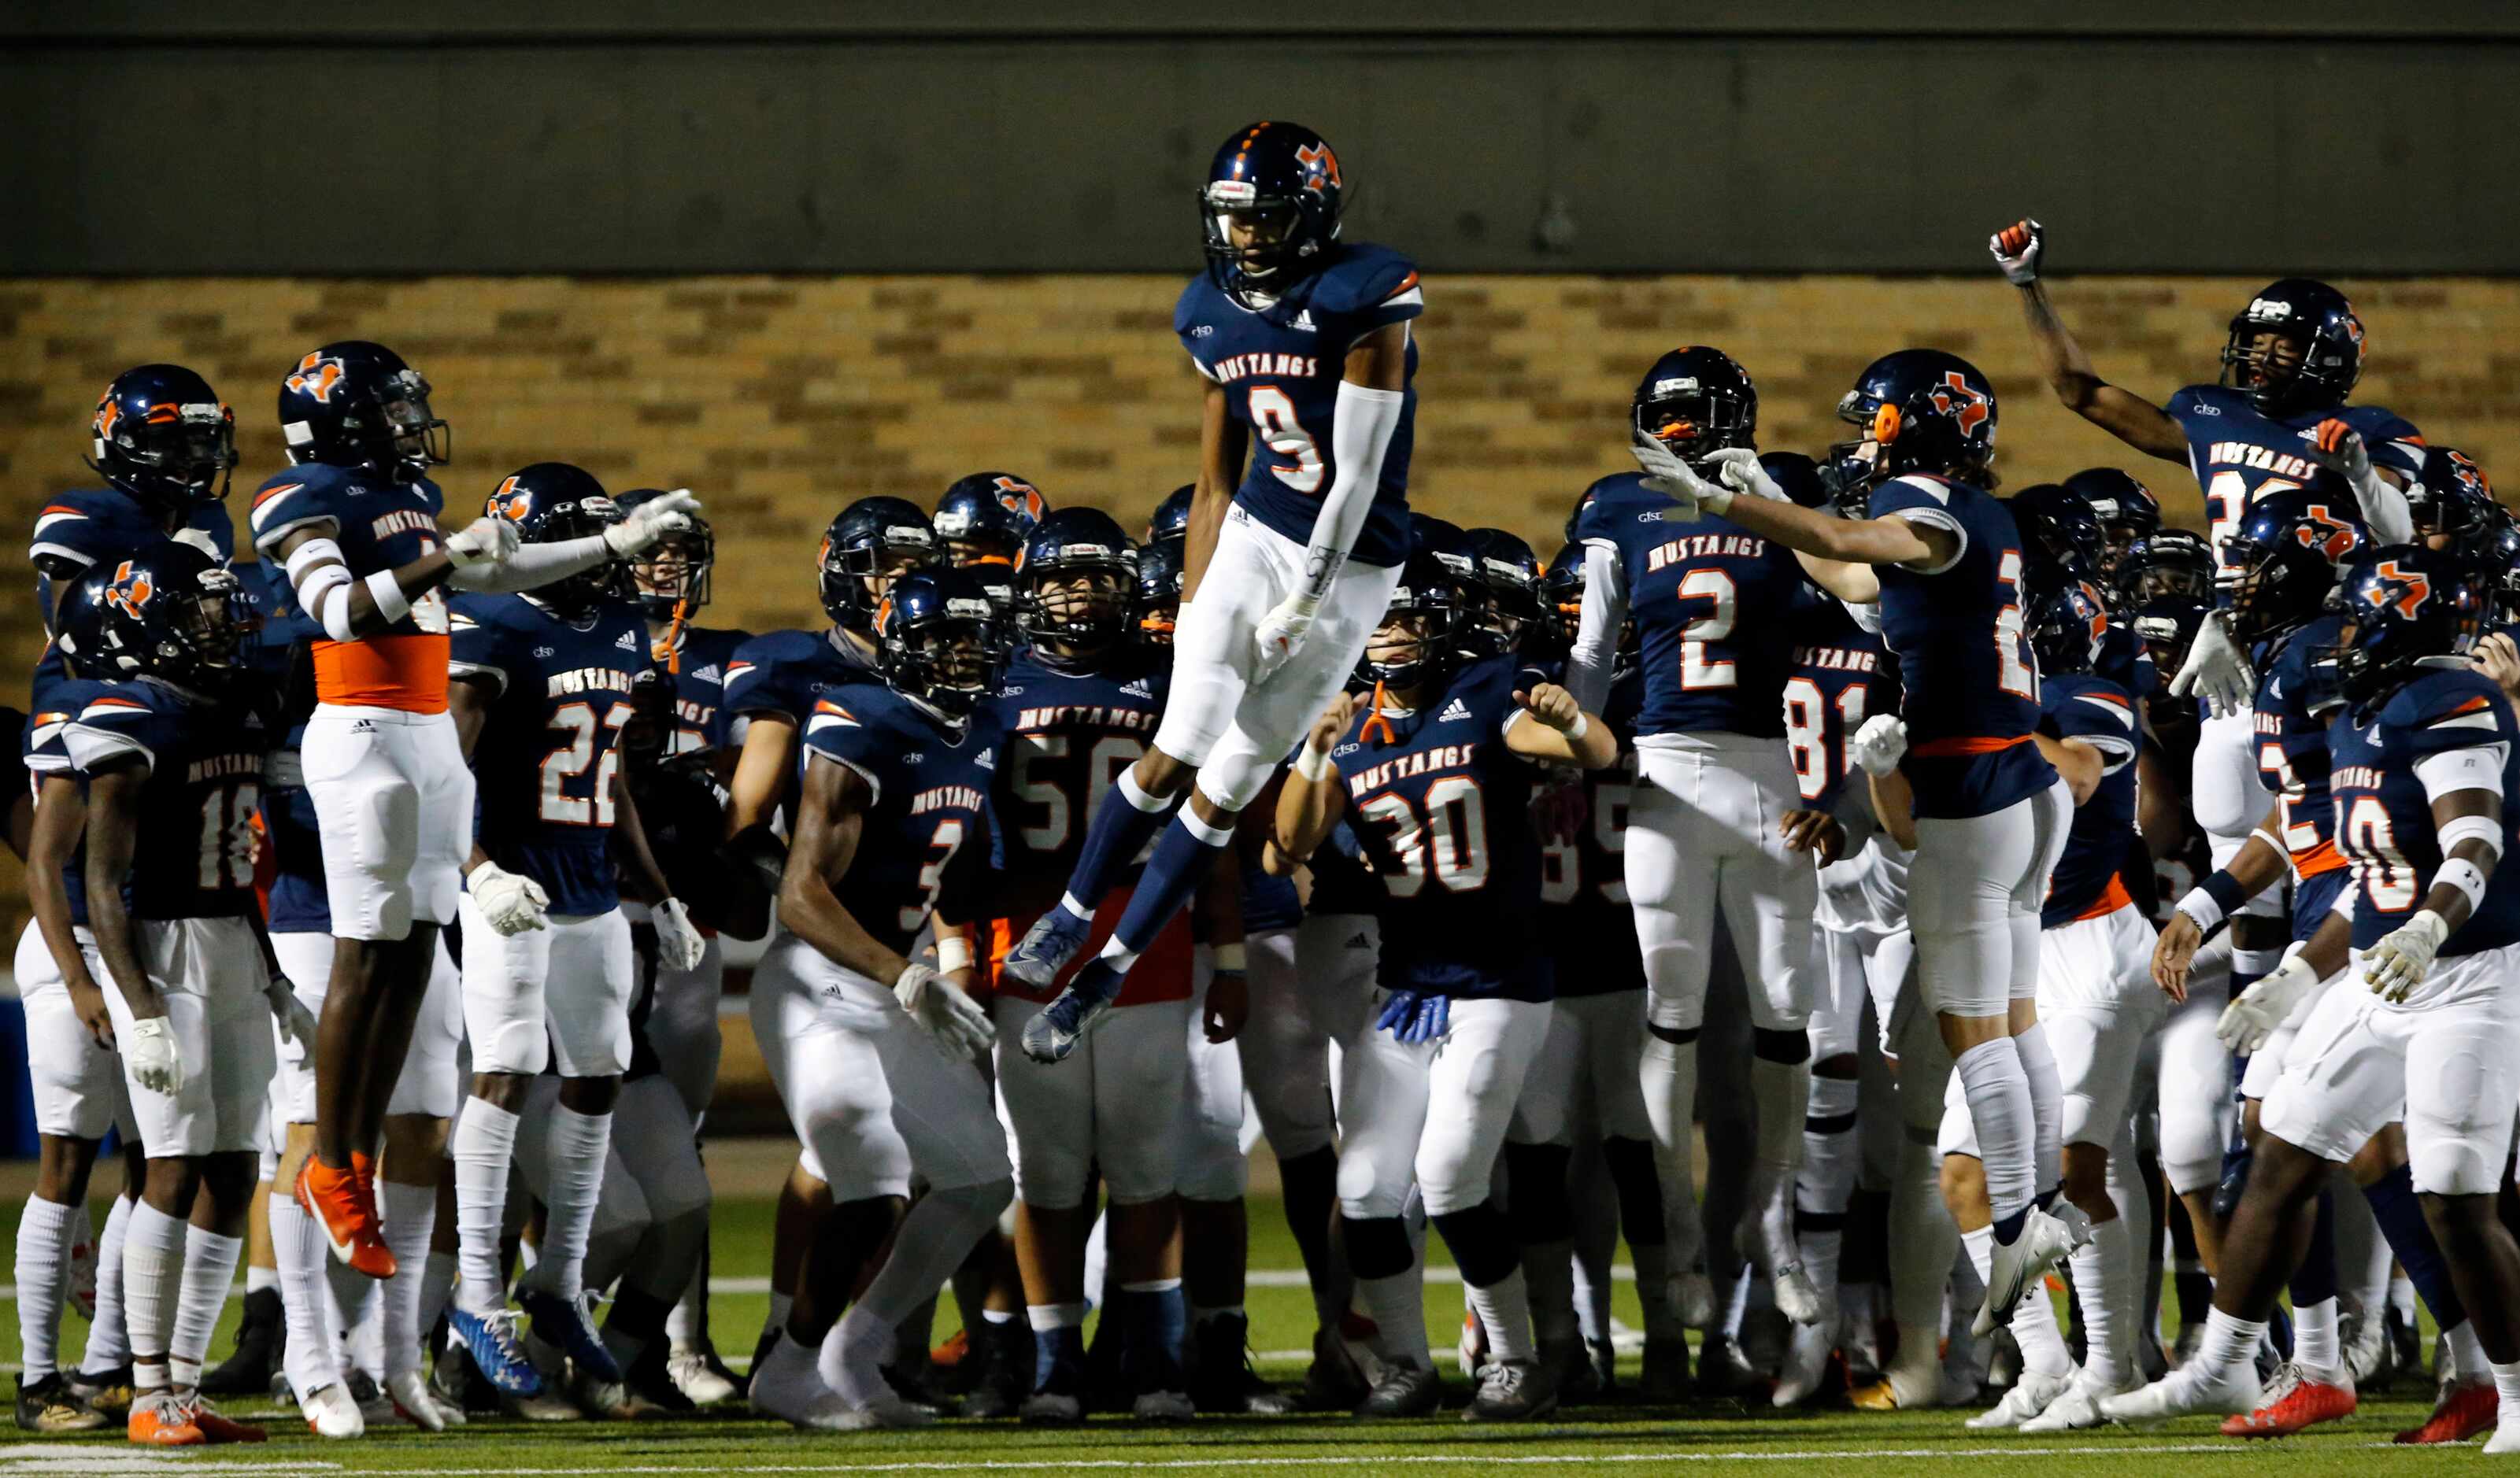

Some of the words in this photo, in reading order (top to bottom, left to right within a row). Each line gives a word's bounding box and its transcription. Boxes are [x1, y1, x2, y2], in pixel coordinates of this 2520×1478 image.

[1215, 353, 1319, 384] MUSTANGS
[1249, 385, 1324, 493] 9
[2209, 441, 2318, 480] MUSTANGS
[2207, 471, 2304, 588] 2
[1648, 534, 1765, 572] MUSTANGS
[1678, 567, 1738, 691] 2
[1119, 687, 1153, 700] adidas
[1438, 711, 1472, 722] adidas
[1016, 705, 1157, 732] MUSTANGS
[1782, 677, 1867, 800] 81
[1333, 743, 1360, 757] GISD
[1349, 744, 1475, 798] MUSTANGS
[910, 785, 983, 815] MUSTANGS
[2261, 742, 2320, 852] 2
[1359, 775, 1489, 898] 30
[899, 819, 962, 930] 3
